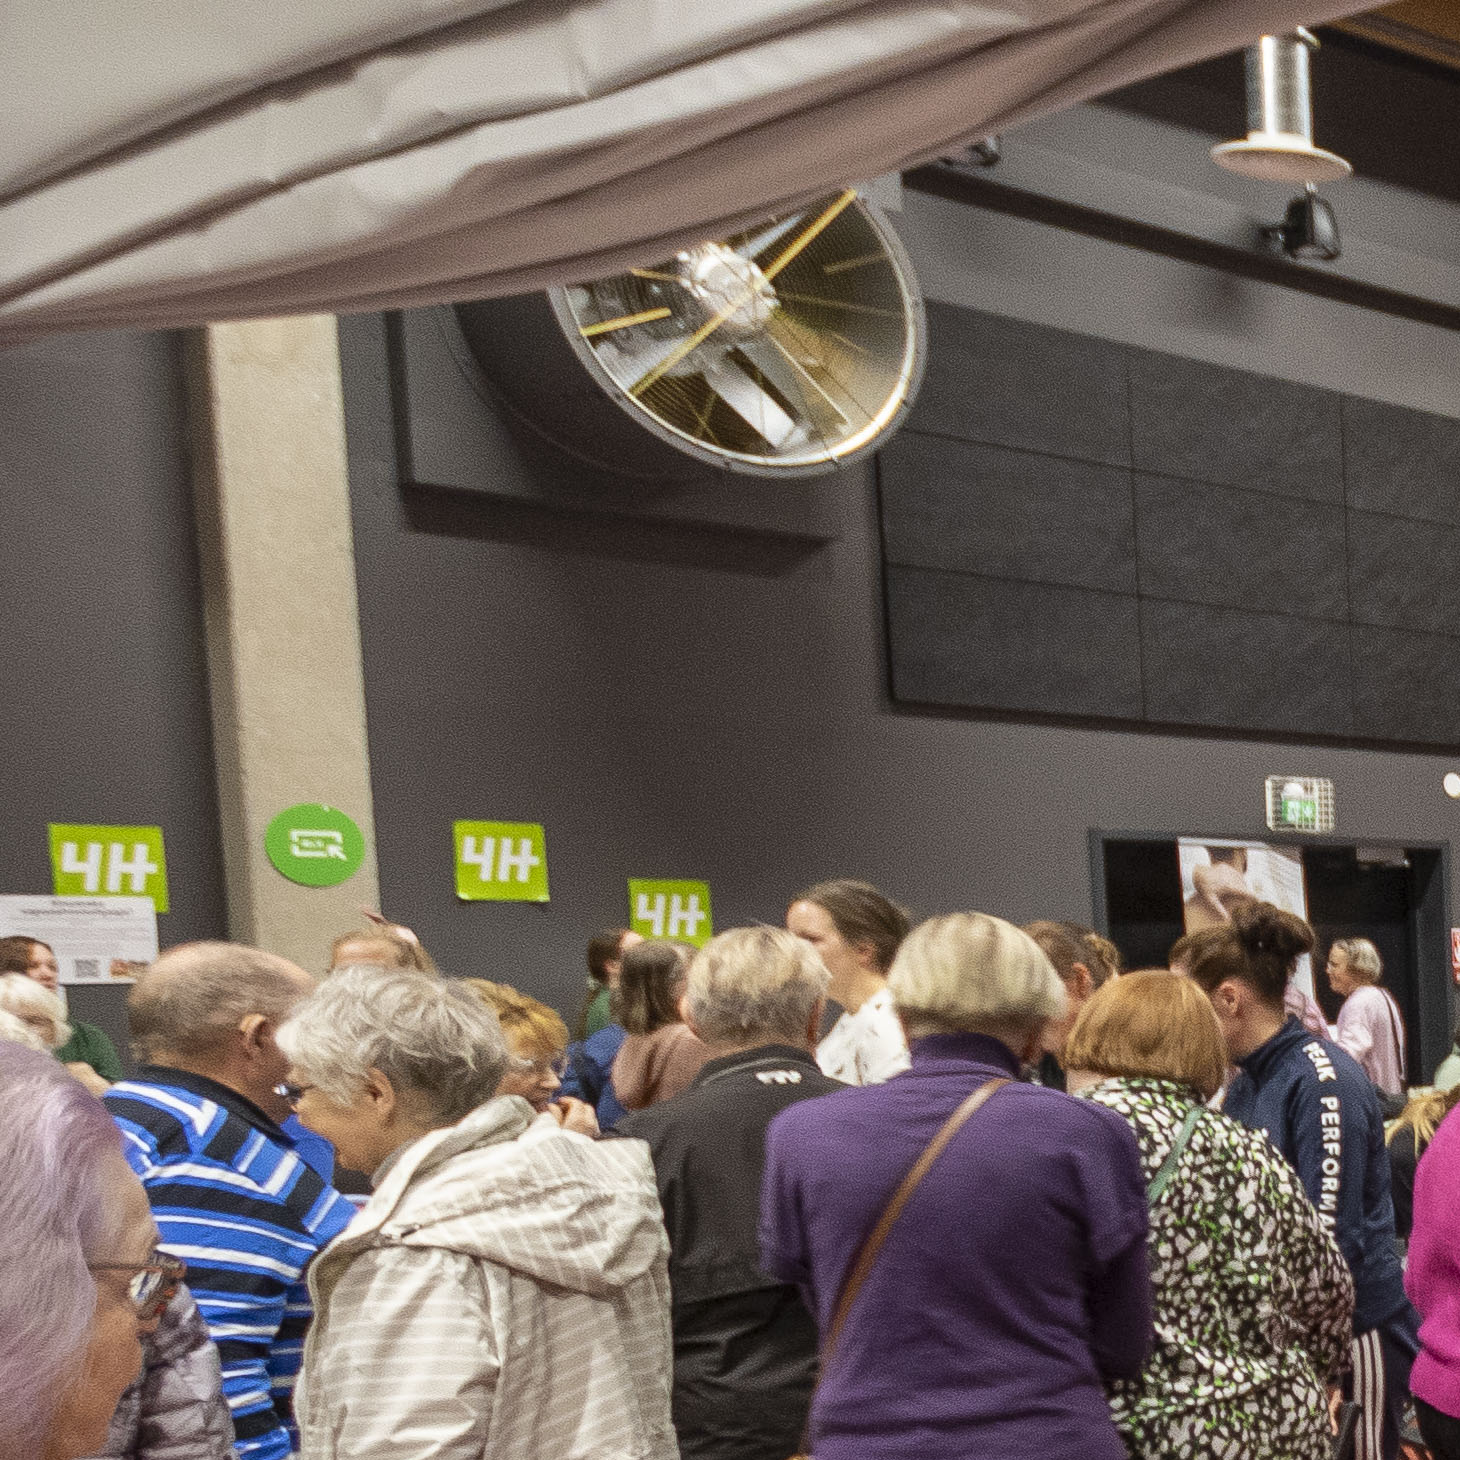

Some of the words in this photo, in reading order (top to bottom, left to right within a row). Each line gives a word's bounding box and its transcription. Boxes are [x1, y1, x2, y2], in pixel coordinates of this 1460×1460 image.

[61, 841, 158, 892] 4H
[462, 836, 540, 883] 4H
[636, 893, 705, 936] 4H
[1302, 1041, 1337, 1082] PEAK
[1319, 1096, 1341, 1232] PERFORMA
